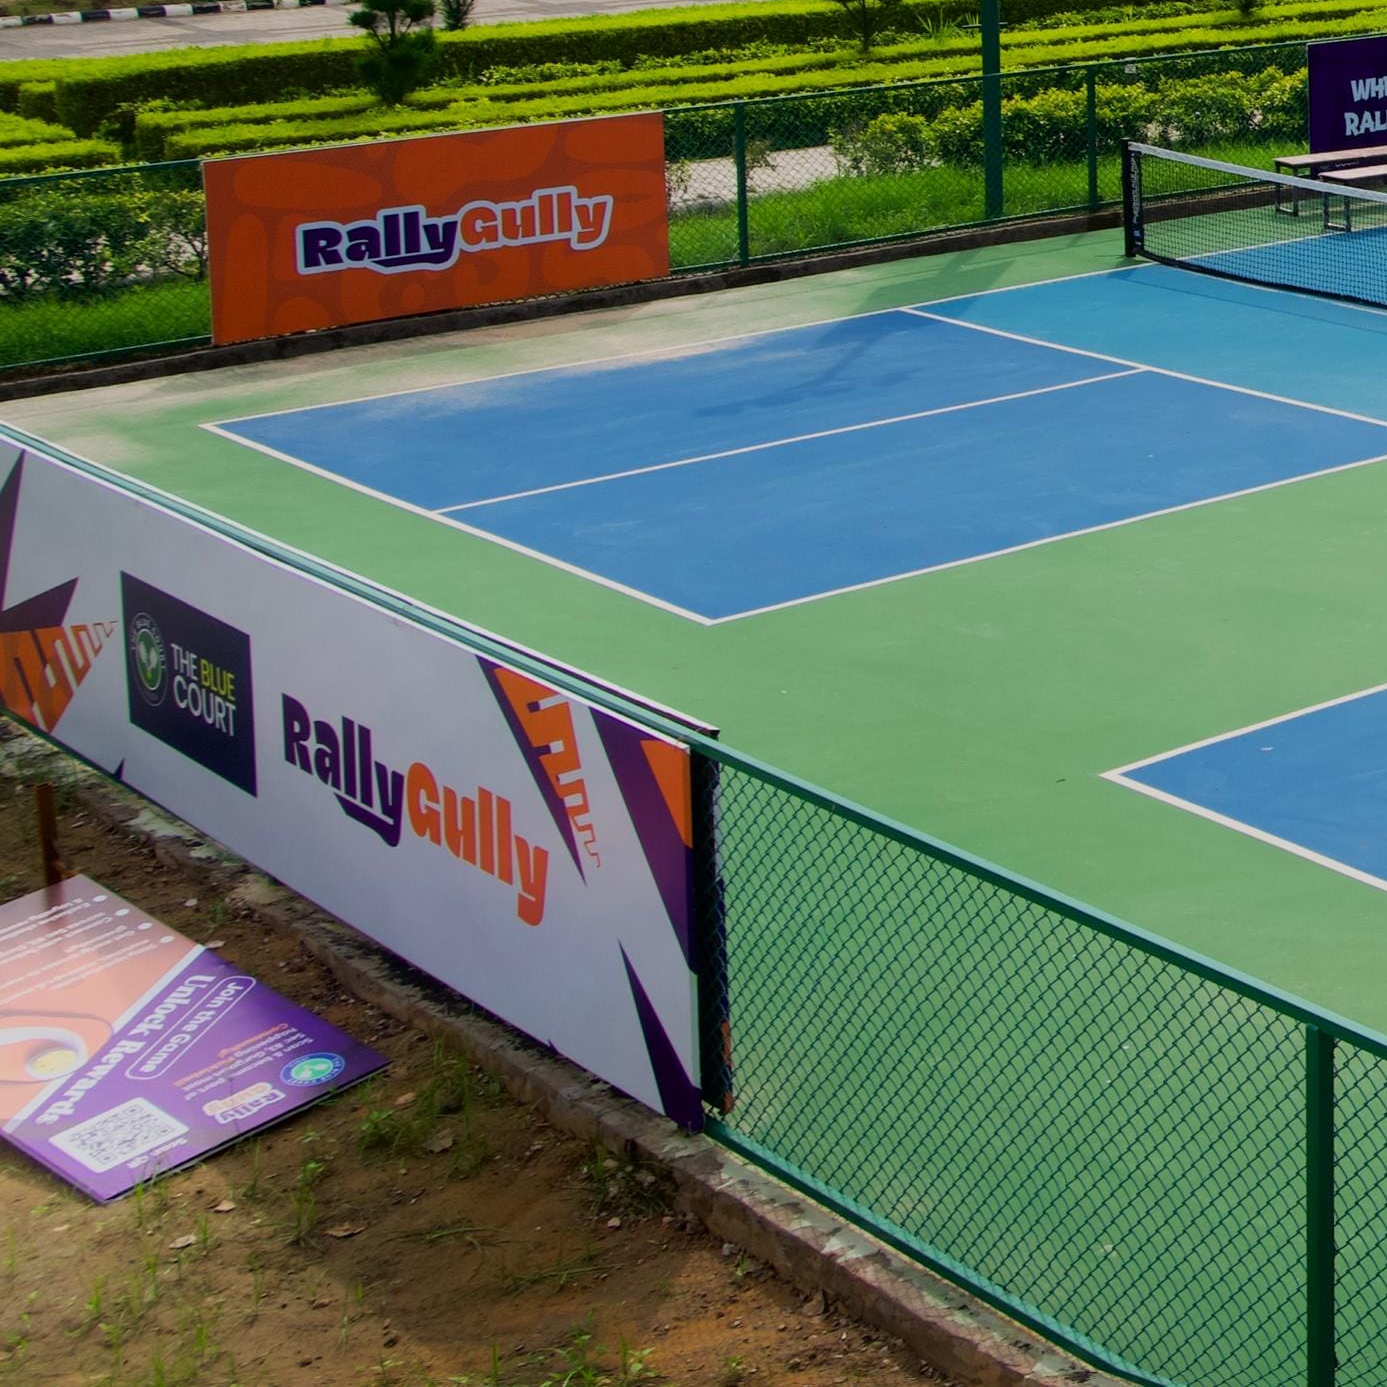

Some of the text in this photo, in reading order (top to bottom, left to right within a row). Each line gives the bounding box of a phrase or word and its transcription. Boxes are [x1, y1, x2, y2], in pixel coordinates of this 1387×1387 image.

[171, 643, 235, 701] THE BLUE
[173, 675, 236, 736] COURT
[33, 975, 215, 1125] Unlock Rewards
[138, 981, 244, 1072] Join the Game
[233, 1026, 297, 1057] happening
[281, 1037, 313, 1052] Scan
[283, 1032, 305, 1043] Sec
